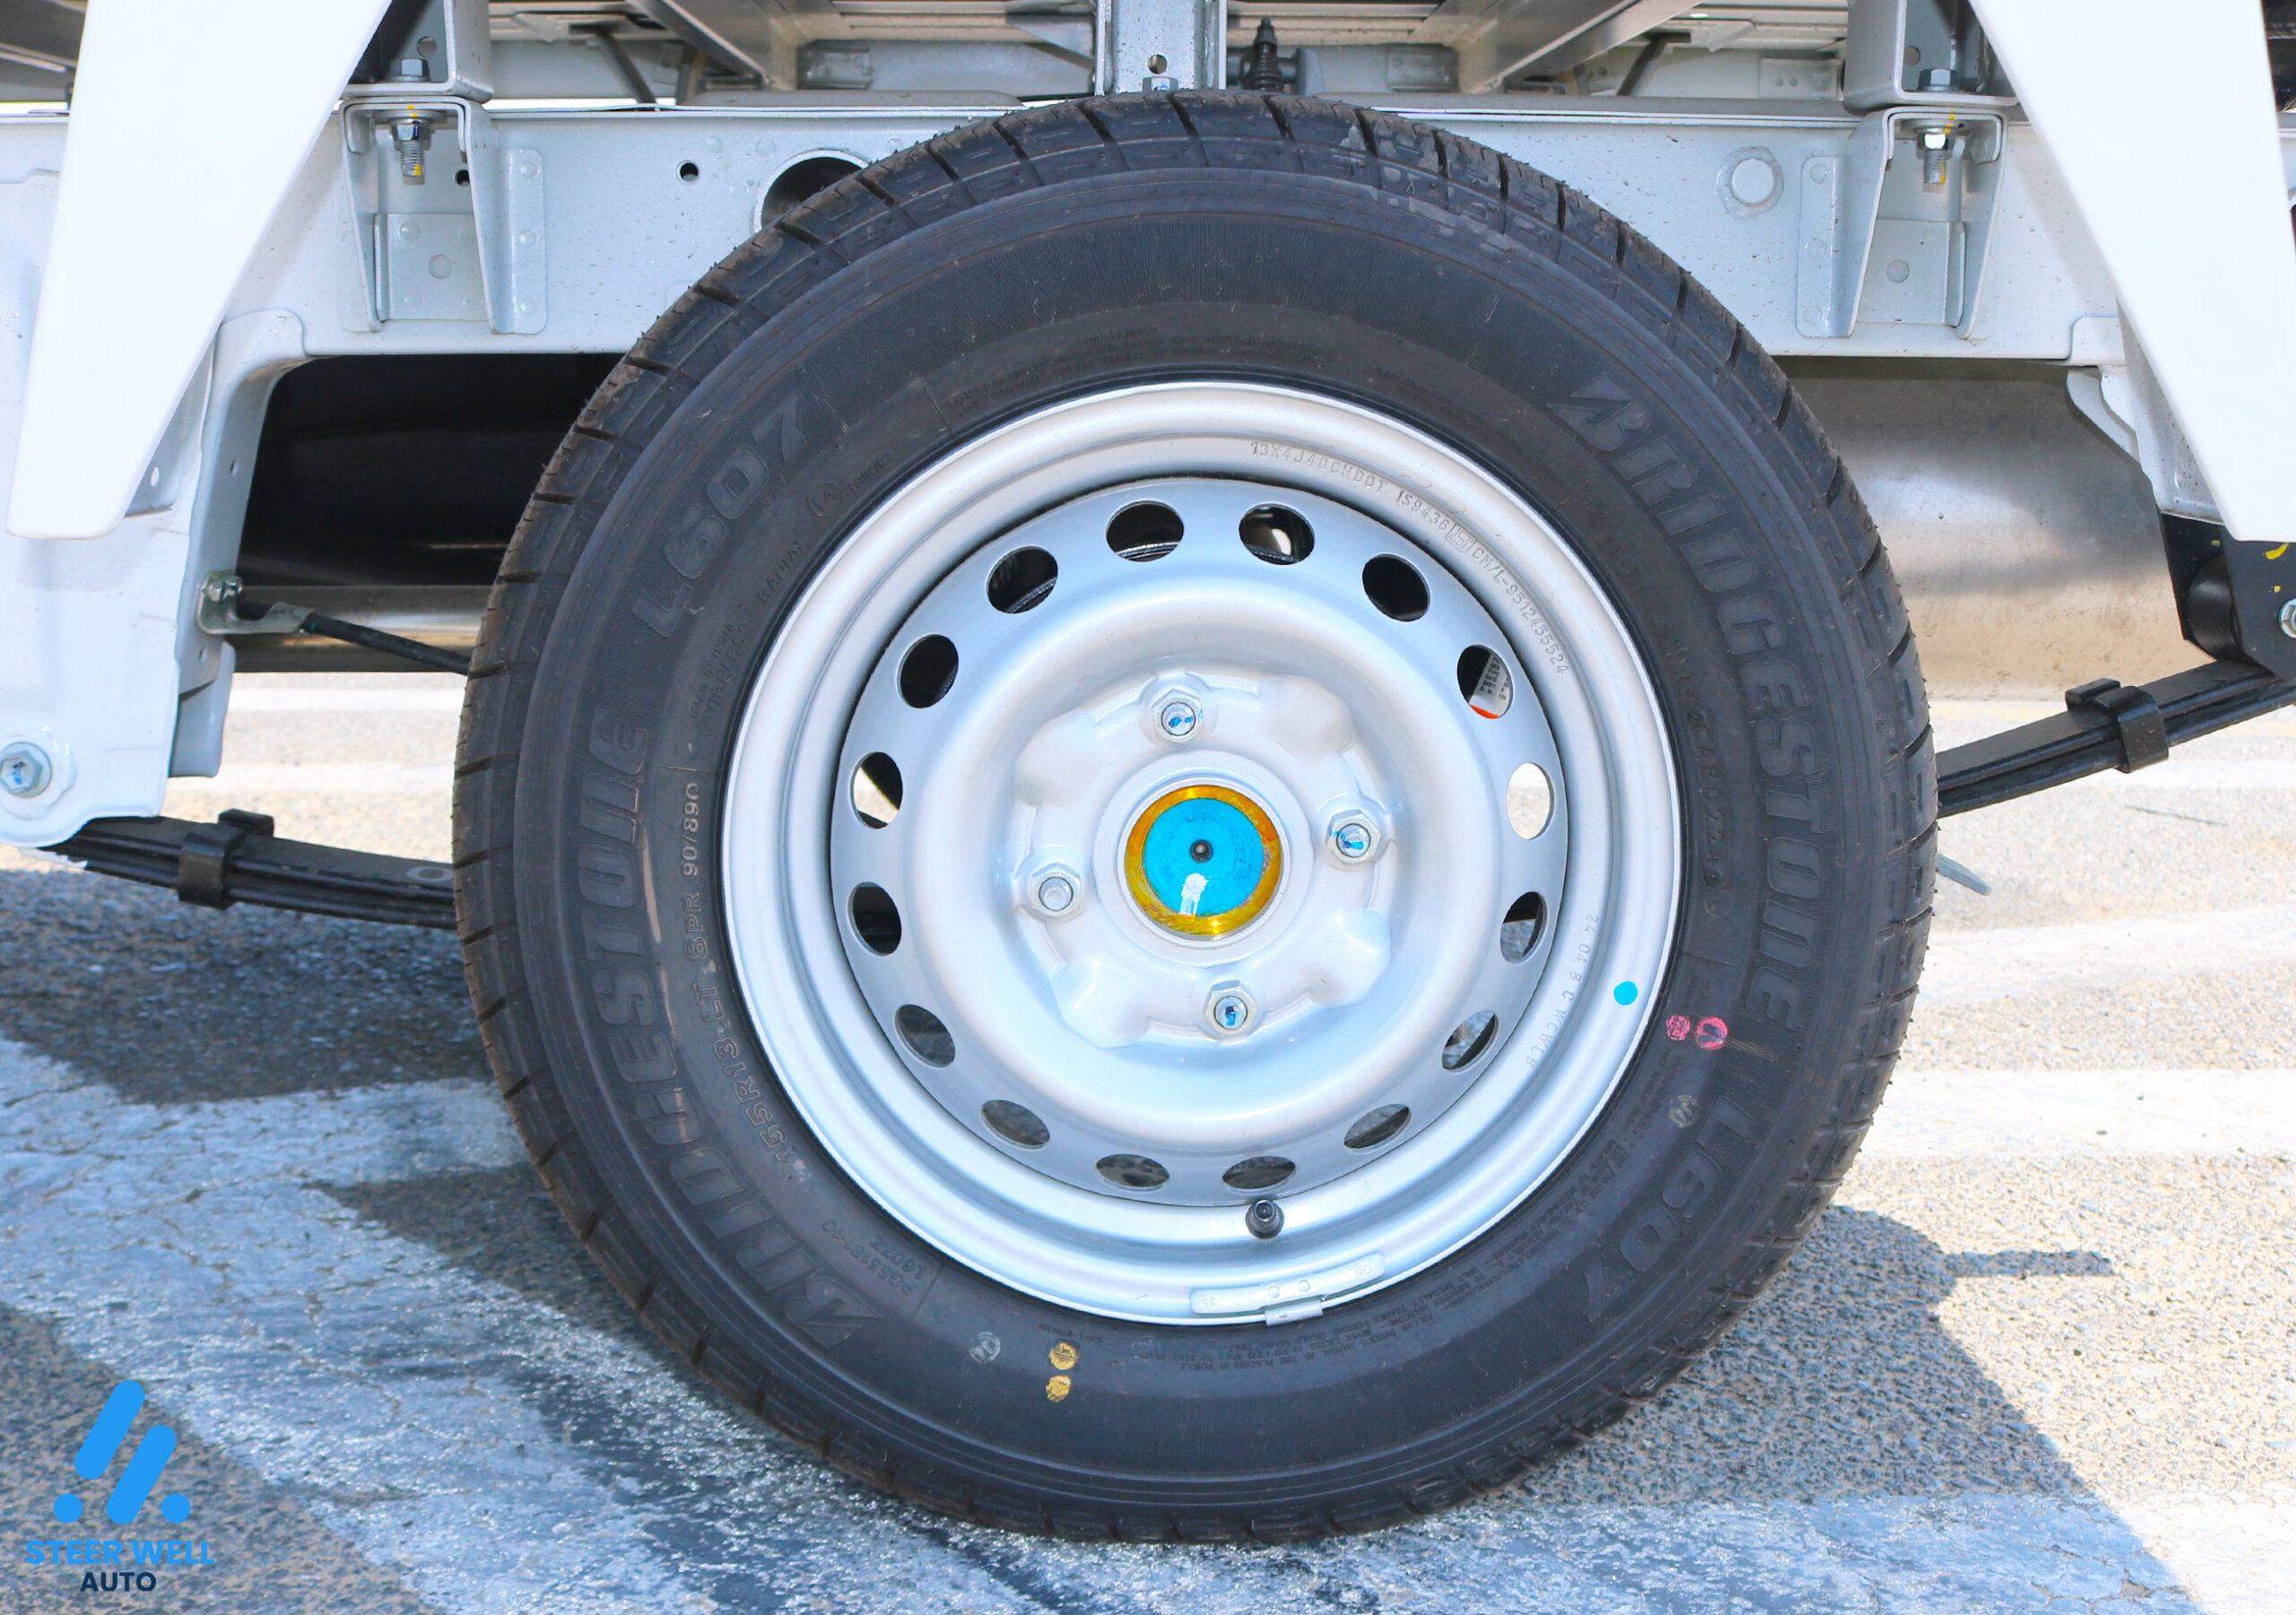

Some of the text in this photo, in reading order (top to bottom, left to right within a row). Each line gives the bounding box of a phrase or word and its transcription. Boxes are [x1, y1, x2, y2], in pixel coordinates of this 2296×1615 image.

[630, 405, 809, 638] L607
[1546, 370, 1827, 1030] BRIDGESTONE
[578, 708, 885, 1347] BRIDGESTONE
[678, 780, 794, 1164] 155R13 LT 8PR 90/890
[1574, 1098, 1753, 1323] L607
